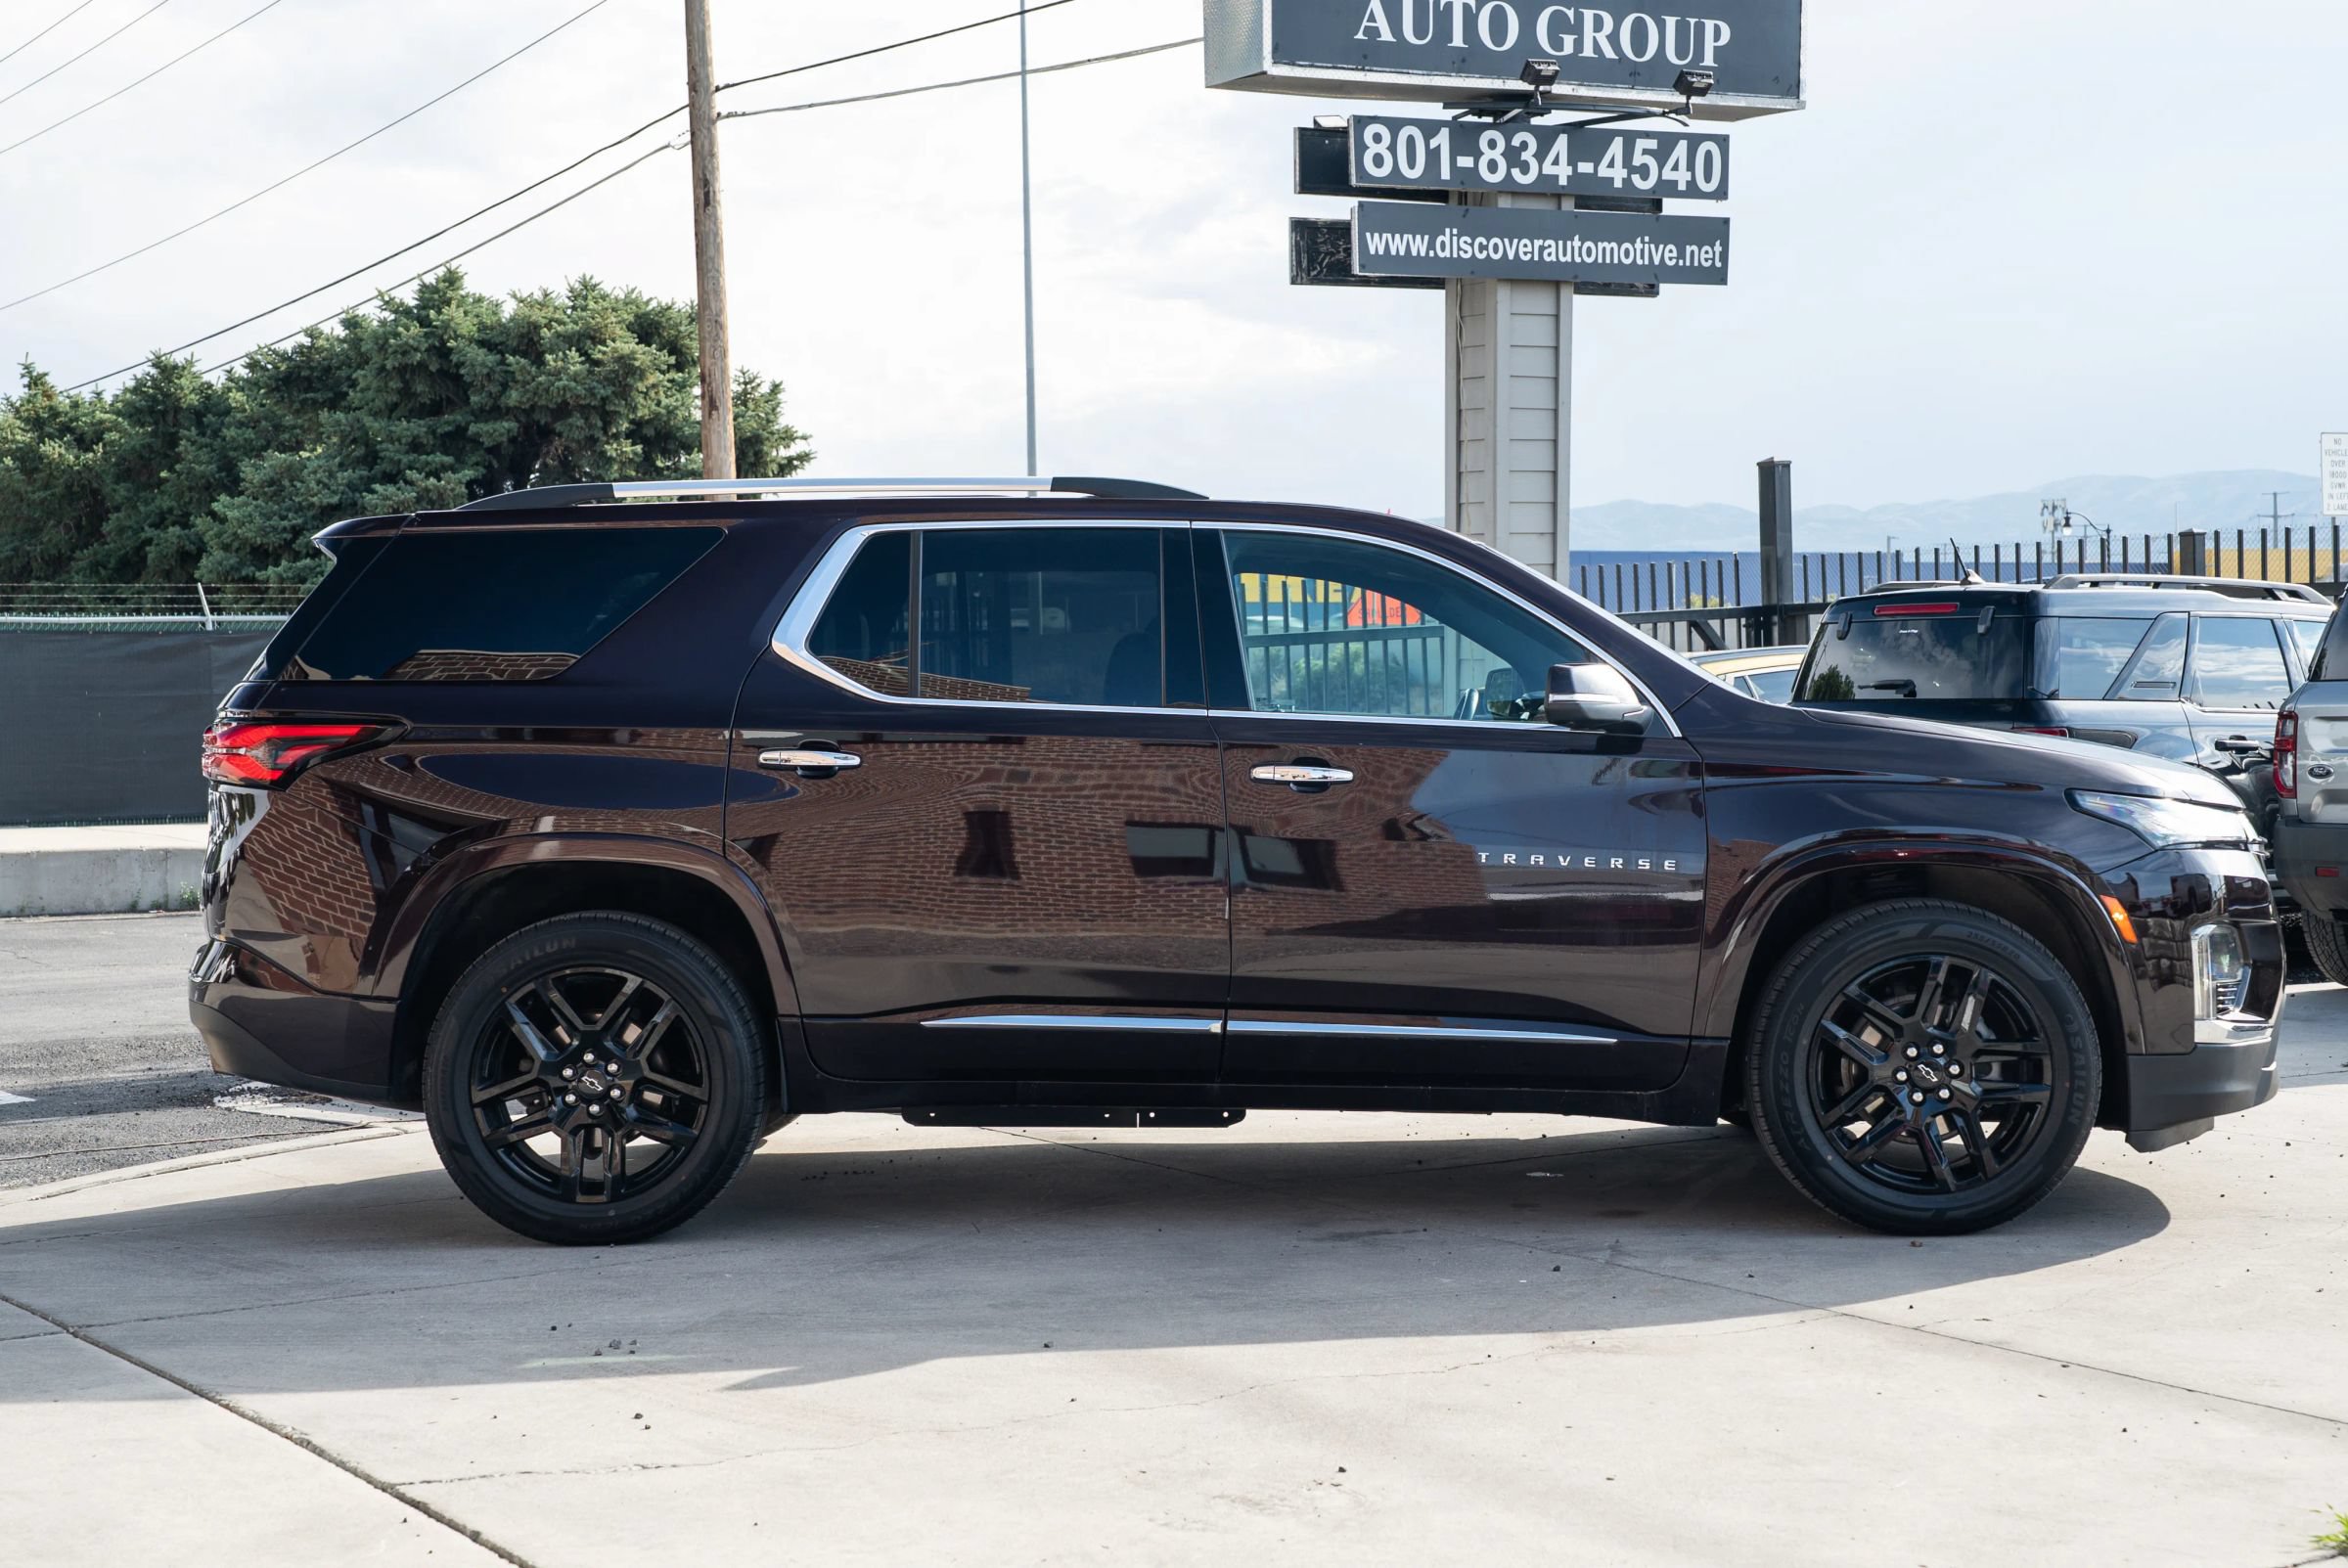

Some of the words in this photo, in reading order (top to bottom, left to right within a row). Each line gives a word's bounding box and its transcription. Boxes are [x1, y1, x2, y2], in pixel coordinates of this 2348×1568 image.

[1353, 0, 1519, 52] AUTO
[1536, 5, 1732, 67] GROUP
[1363, 123, 1722, 193] 801-834-4540
[1366, 228, 1723, 268] www.discoverautomotive.net
[2325, 448, 2348, 457] VEHICLE
[1478, 852, 1677, 871] TRAVERSE
[2066, 1035, 2086, 1126] SAILUN
